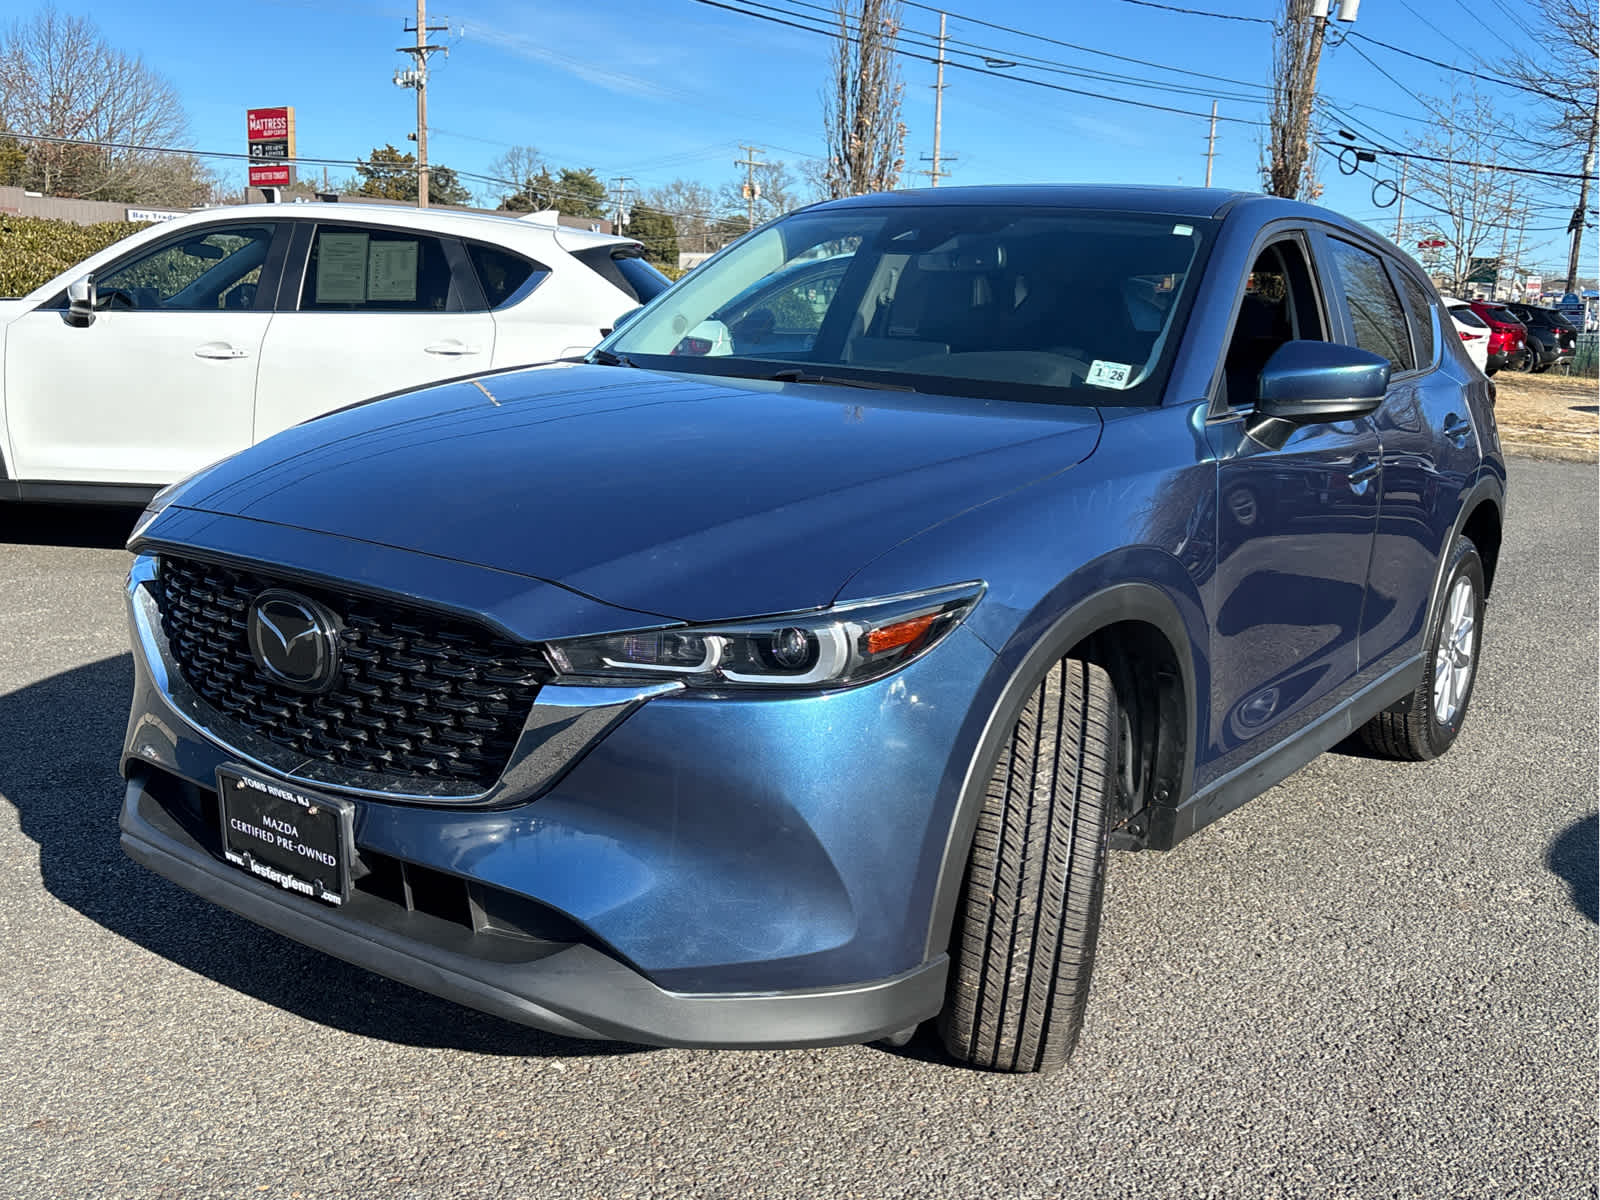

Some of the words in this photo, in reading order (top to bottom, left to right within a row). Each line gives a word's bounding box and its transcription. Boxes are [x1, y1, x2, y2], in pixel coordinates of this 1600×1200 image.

[250, 117, 286, 130] MATTRESS
[1095, 368, 1102, 377] 1
[1110, 370, 1125, 381] 28
[242, 776, 267, 793] TOMS
[297, 795, 310, 807] NJ
[263, 815, 298, 838] MAZDA
[230, 818, 274, 843] CERTIFIED
[277, 836, 336, 867] PRE-OWNED
